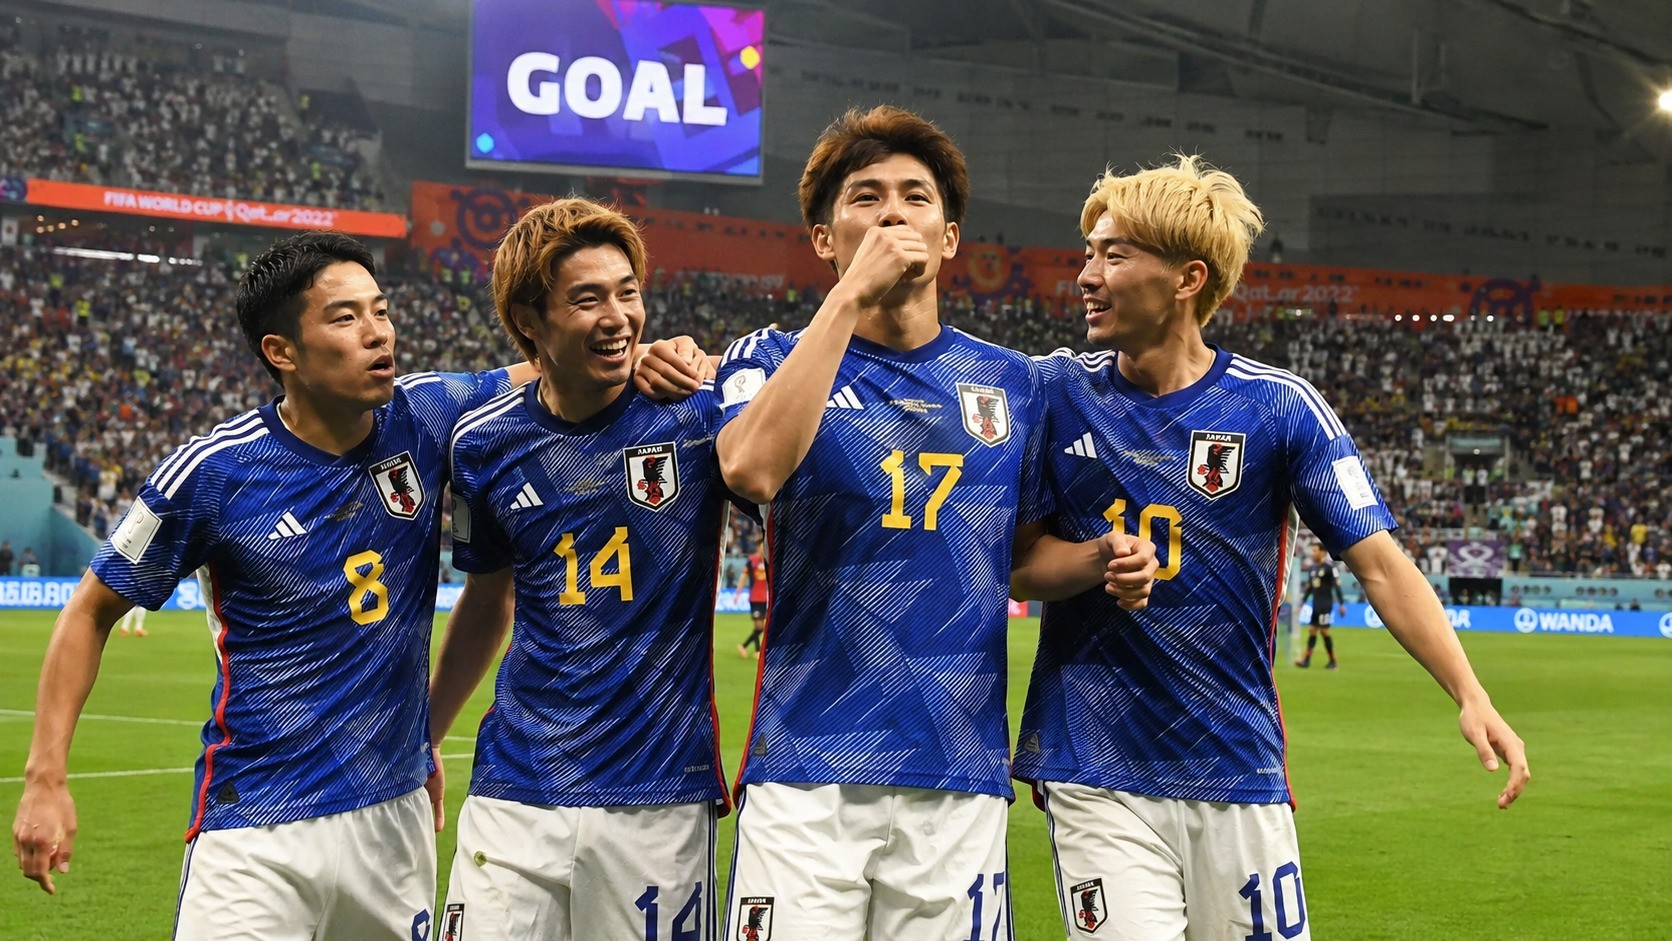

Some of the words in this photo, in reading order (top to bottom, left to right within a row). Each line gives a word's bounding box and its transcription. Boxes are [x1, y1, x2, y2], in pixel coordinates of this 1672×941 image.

[507, 52, 728, 126] GOAL
[104, 191, 137, 208] FIFA
[138, 195, 192, 214] WORLD
[193, 200, 224, 216] CUP
[880, 449, 964, 531] 17
[343, 550, 390, 626] 8
[554, 526, 633, 605] 14
[1539, 612, 1615, 634] WANDA
[1239, 861, 1306, 941] 10
